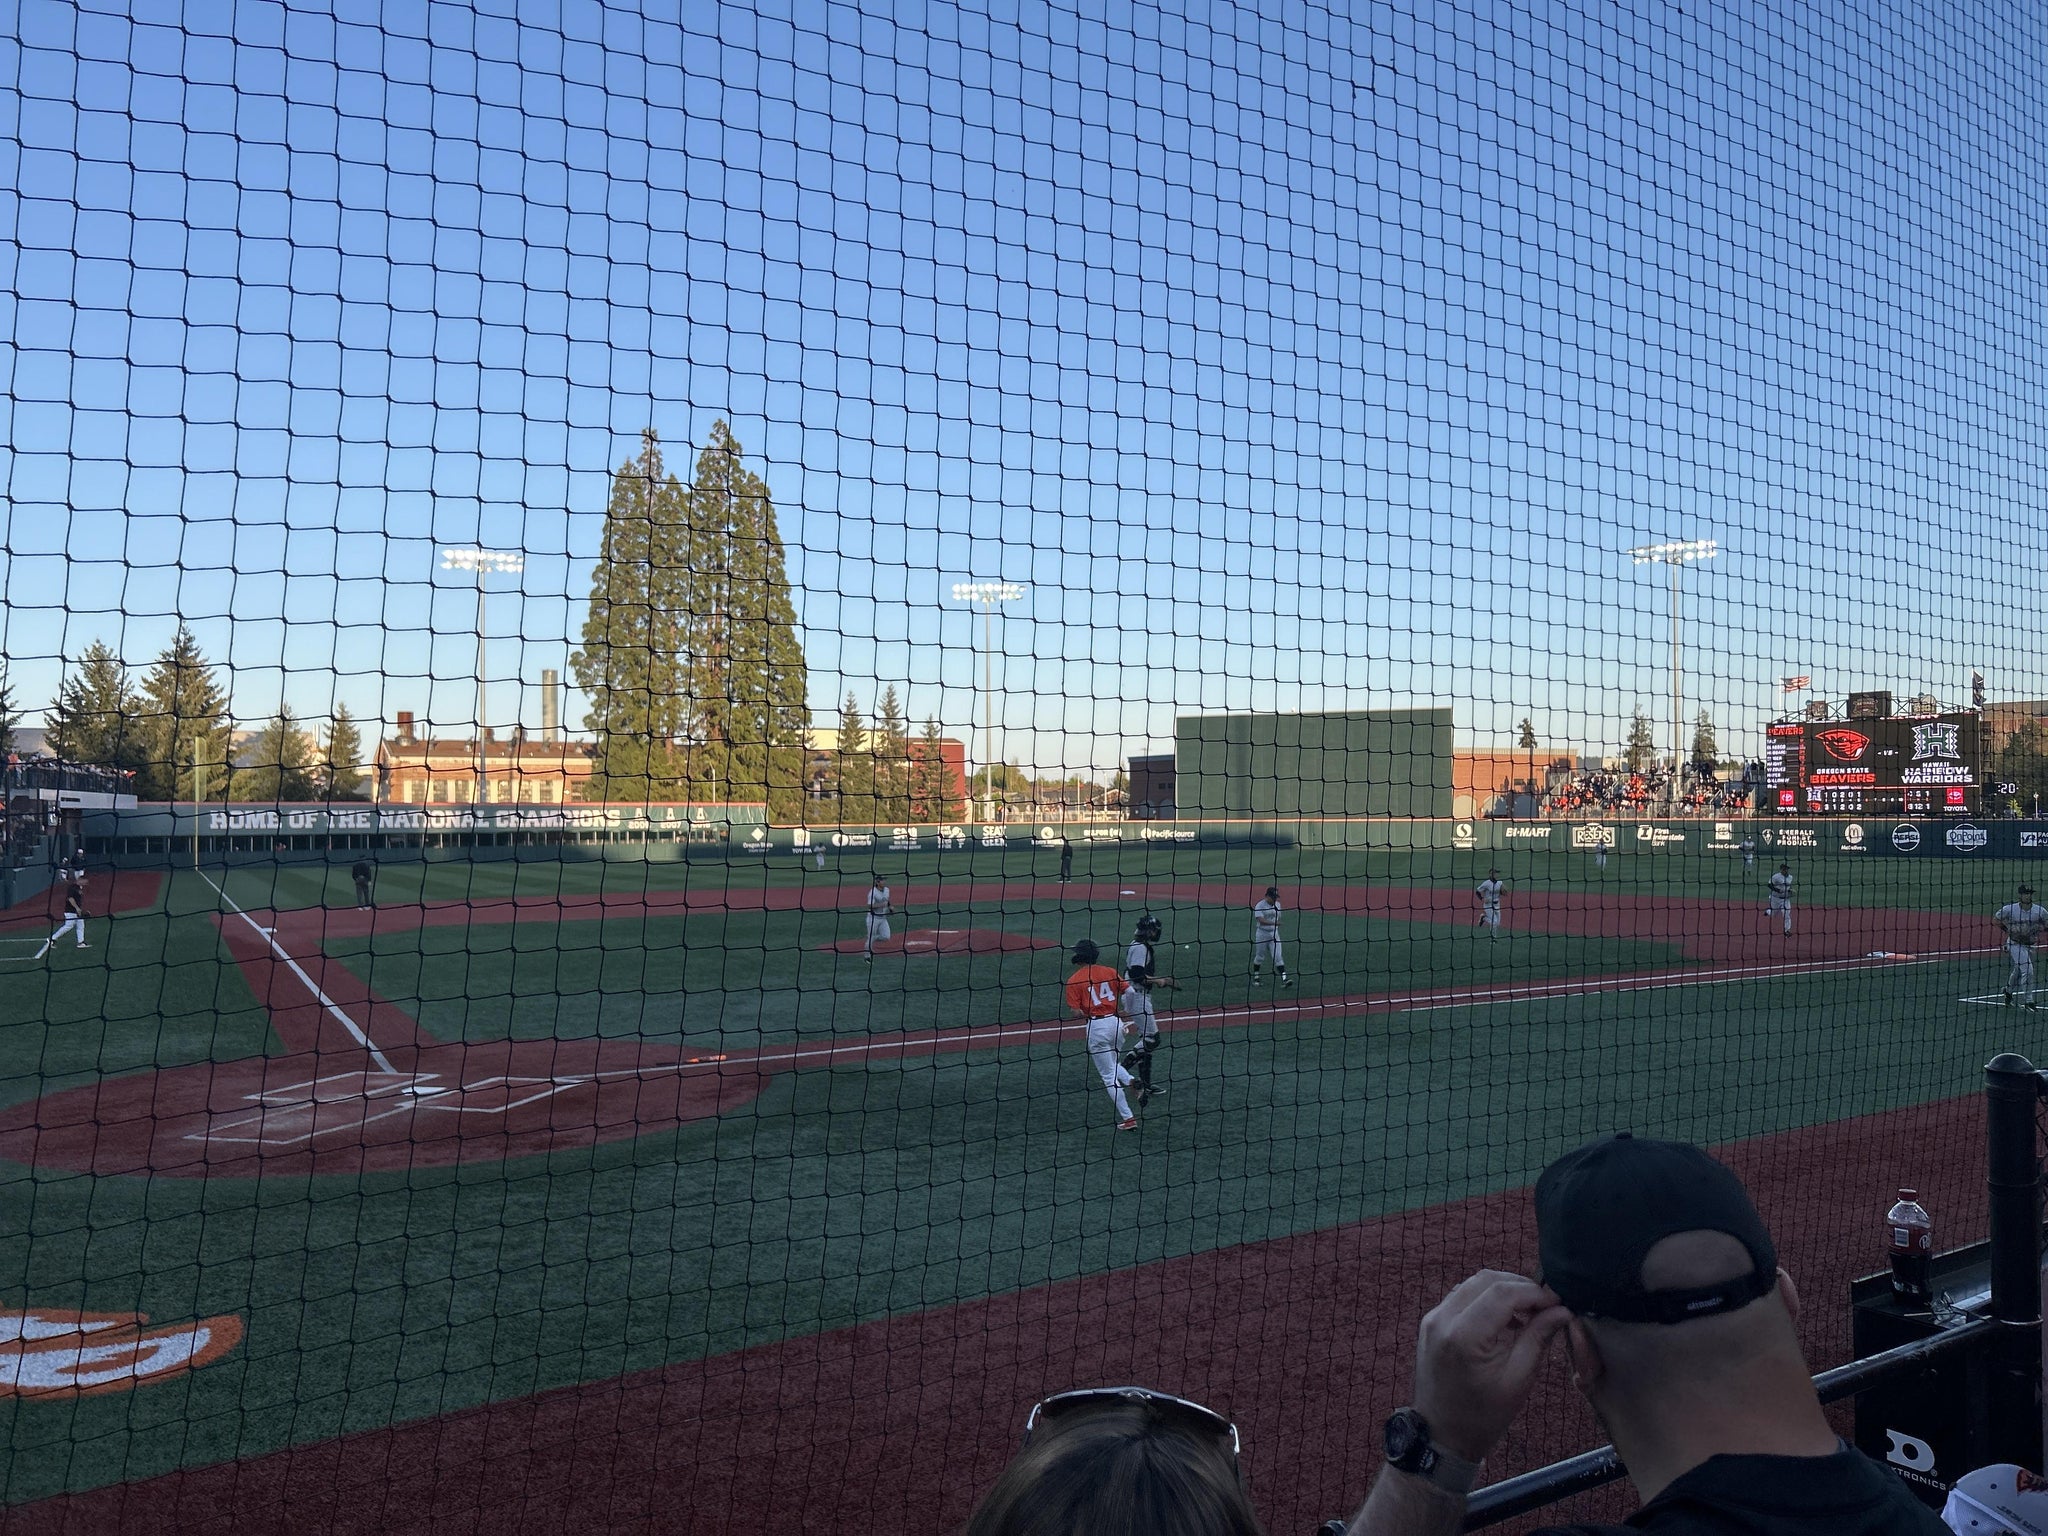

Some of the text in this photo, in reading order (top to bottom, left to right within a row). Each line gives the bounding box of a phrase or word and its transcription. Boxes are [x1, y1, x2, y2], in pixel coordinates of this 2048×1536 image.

[1904, 767, 1969, 776] RAINBOW
[1810, 774, 1876, 784] BEAVERS
[1901, 775, 1973, 784] WARRIORS
[209, 810, 621, 830] HOME OF THE NATIONAL CHAMPIONS
[983, 825, 1007, 837] SEAT
[1087, 981, 1116, 1006] 14
[1891, 1467, 1946, 1491] TRONICS
